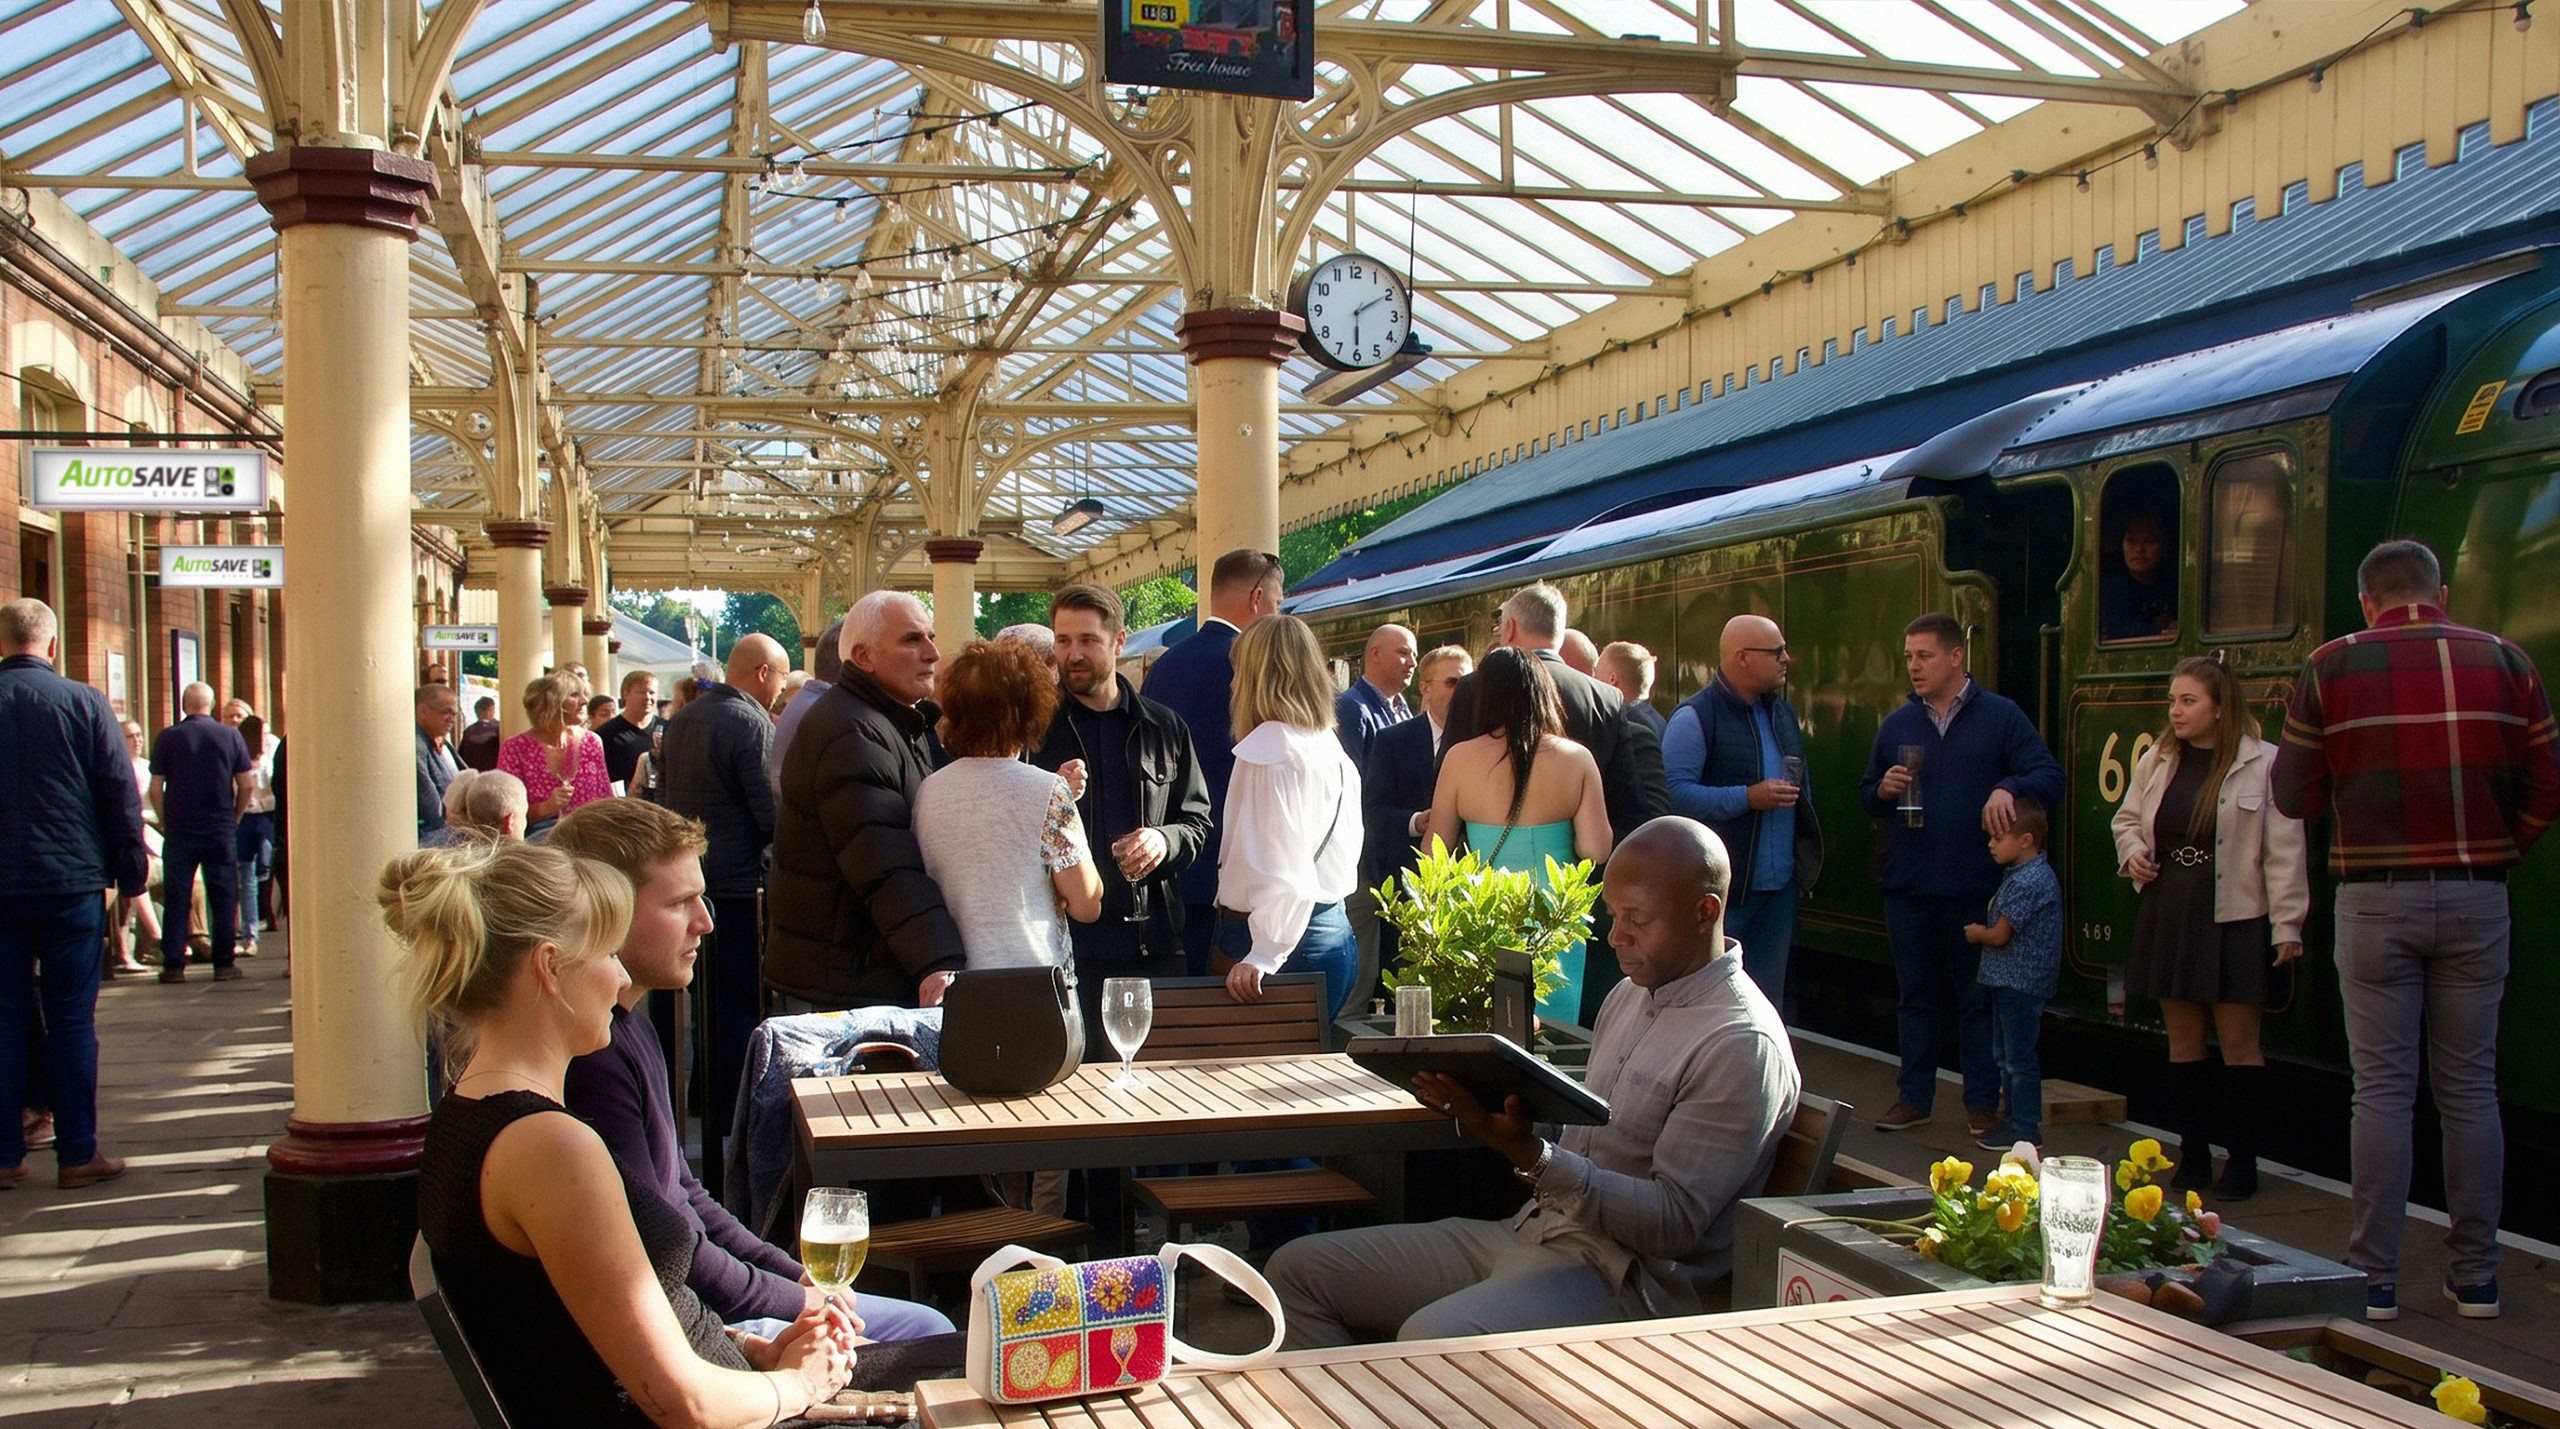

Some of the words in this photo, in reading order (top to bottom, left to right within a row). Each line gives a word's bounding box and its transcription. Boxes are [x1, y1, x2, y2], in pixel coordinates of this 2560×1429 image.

[1166, 52, 1205, 73] Free
[1207, 57, 1251, 78] house
[1333, 268, 1341, 282] 11
[1349, 265, 1362, 279] 12
[1318, 283, 1330, 296] 10
[1384, 288, 1393, 301] 2
[1314, 304, 1323, 317] 9
[1390, 310, 1399, 323] 3
[1321, 325, 1330, 339] 8
[1385, 330, 1394, 344] 4
[1335, 342, 1344, 356] 7
[1352, 348, 1362, 362] 6
[1372, 344, 1381, 357] 5
